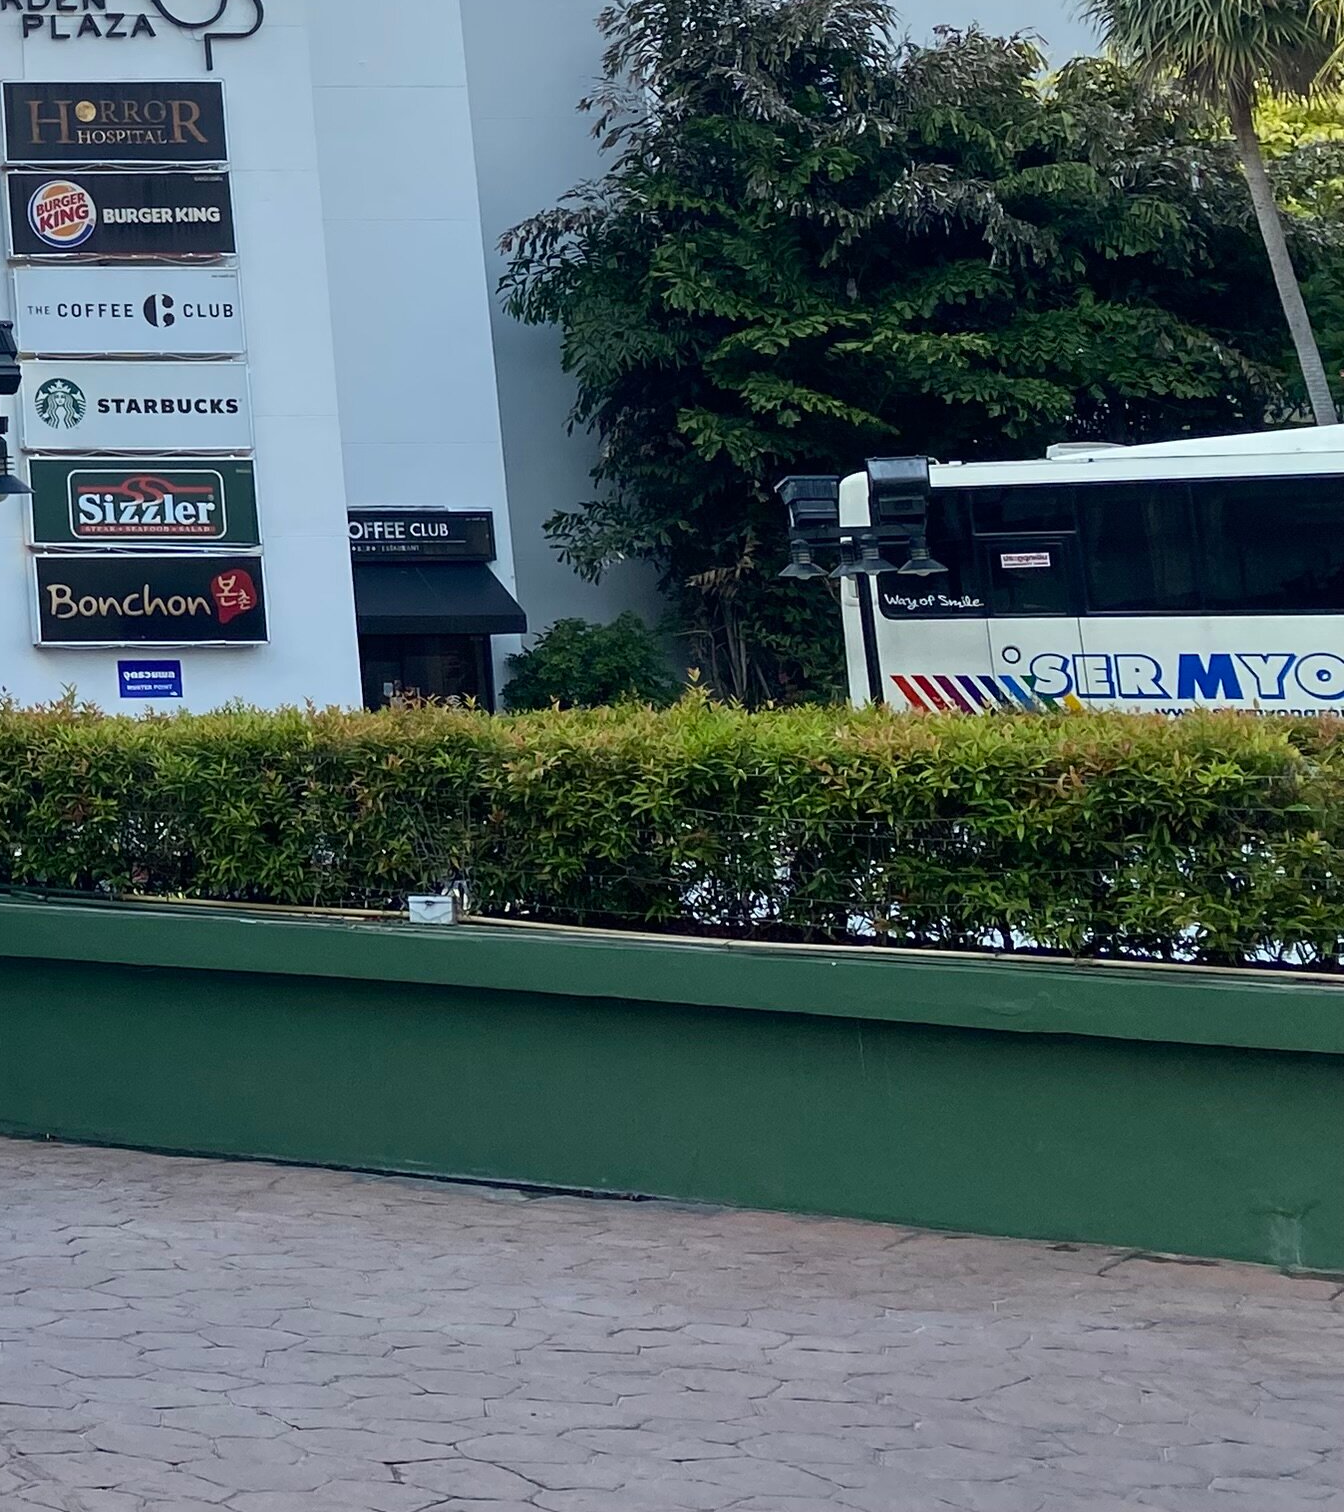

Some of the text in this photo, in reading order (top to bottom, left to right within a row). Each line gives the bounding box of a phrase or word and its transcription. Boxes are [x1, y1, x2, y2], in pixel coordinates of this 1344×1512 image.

[22, 13, 157, 40] PLAZA
[76, 129, 169, 145] HOSPITAL
[35, 191, 86, 218] BURGER
[39, 204, 90, 235] KING
[102, 206, 221, 224] BURGER KING
[27, 305, 51, 316] THE
[57, 303, 134, 318] COFFEE
[182, 303, 234, 318] CLUB
[97, 398, 239, 414] STARBUCKS
[79, 493, 216, 526] Sizzler
[410, 523, 449, 537] CLUB
[46, 583, 212, 619] Bonchon
[884, 593, 984, 610] Way of Smile
